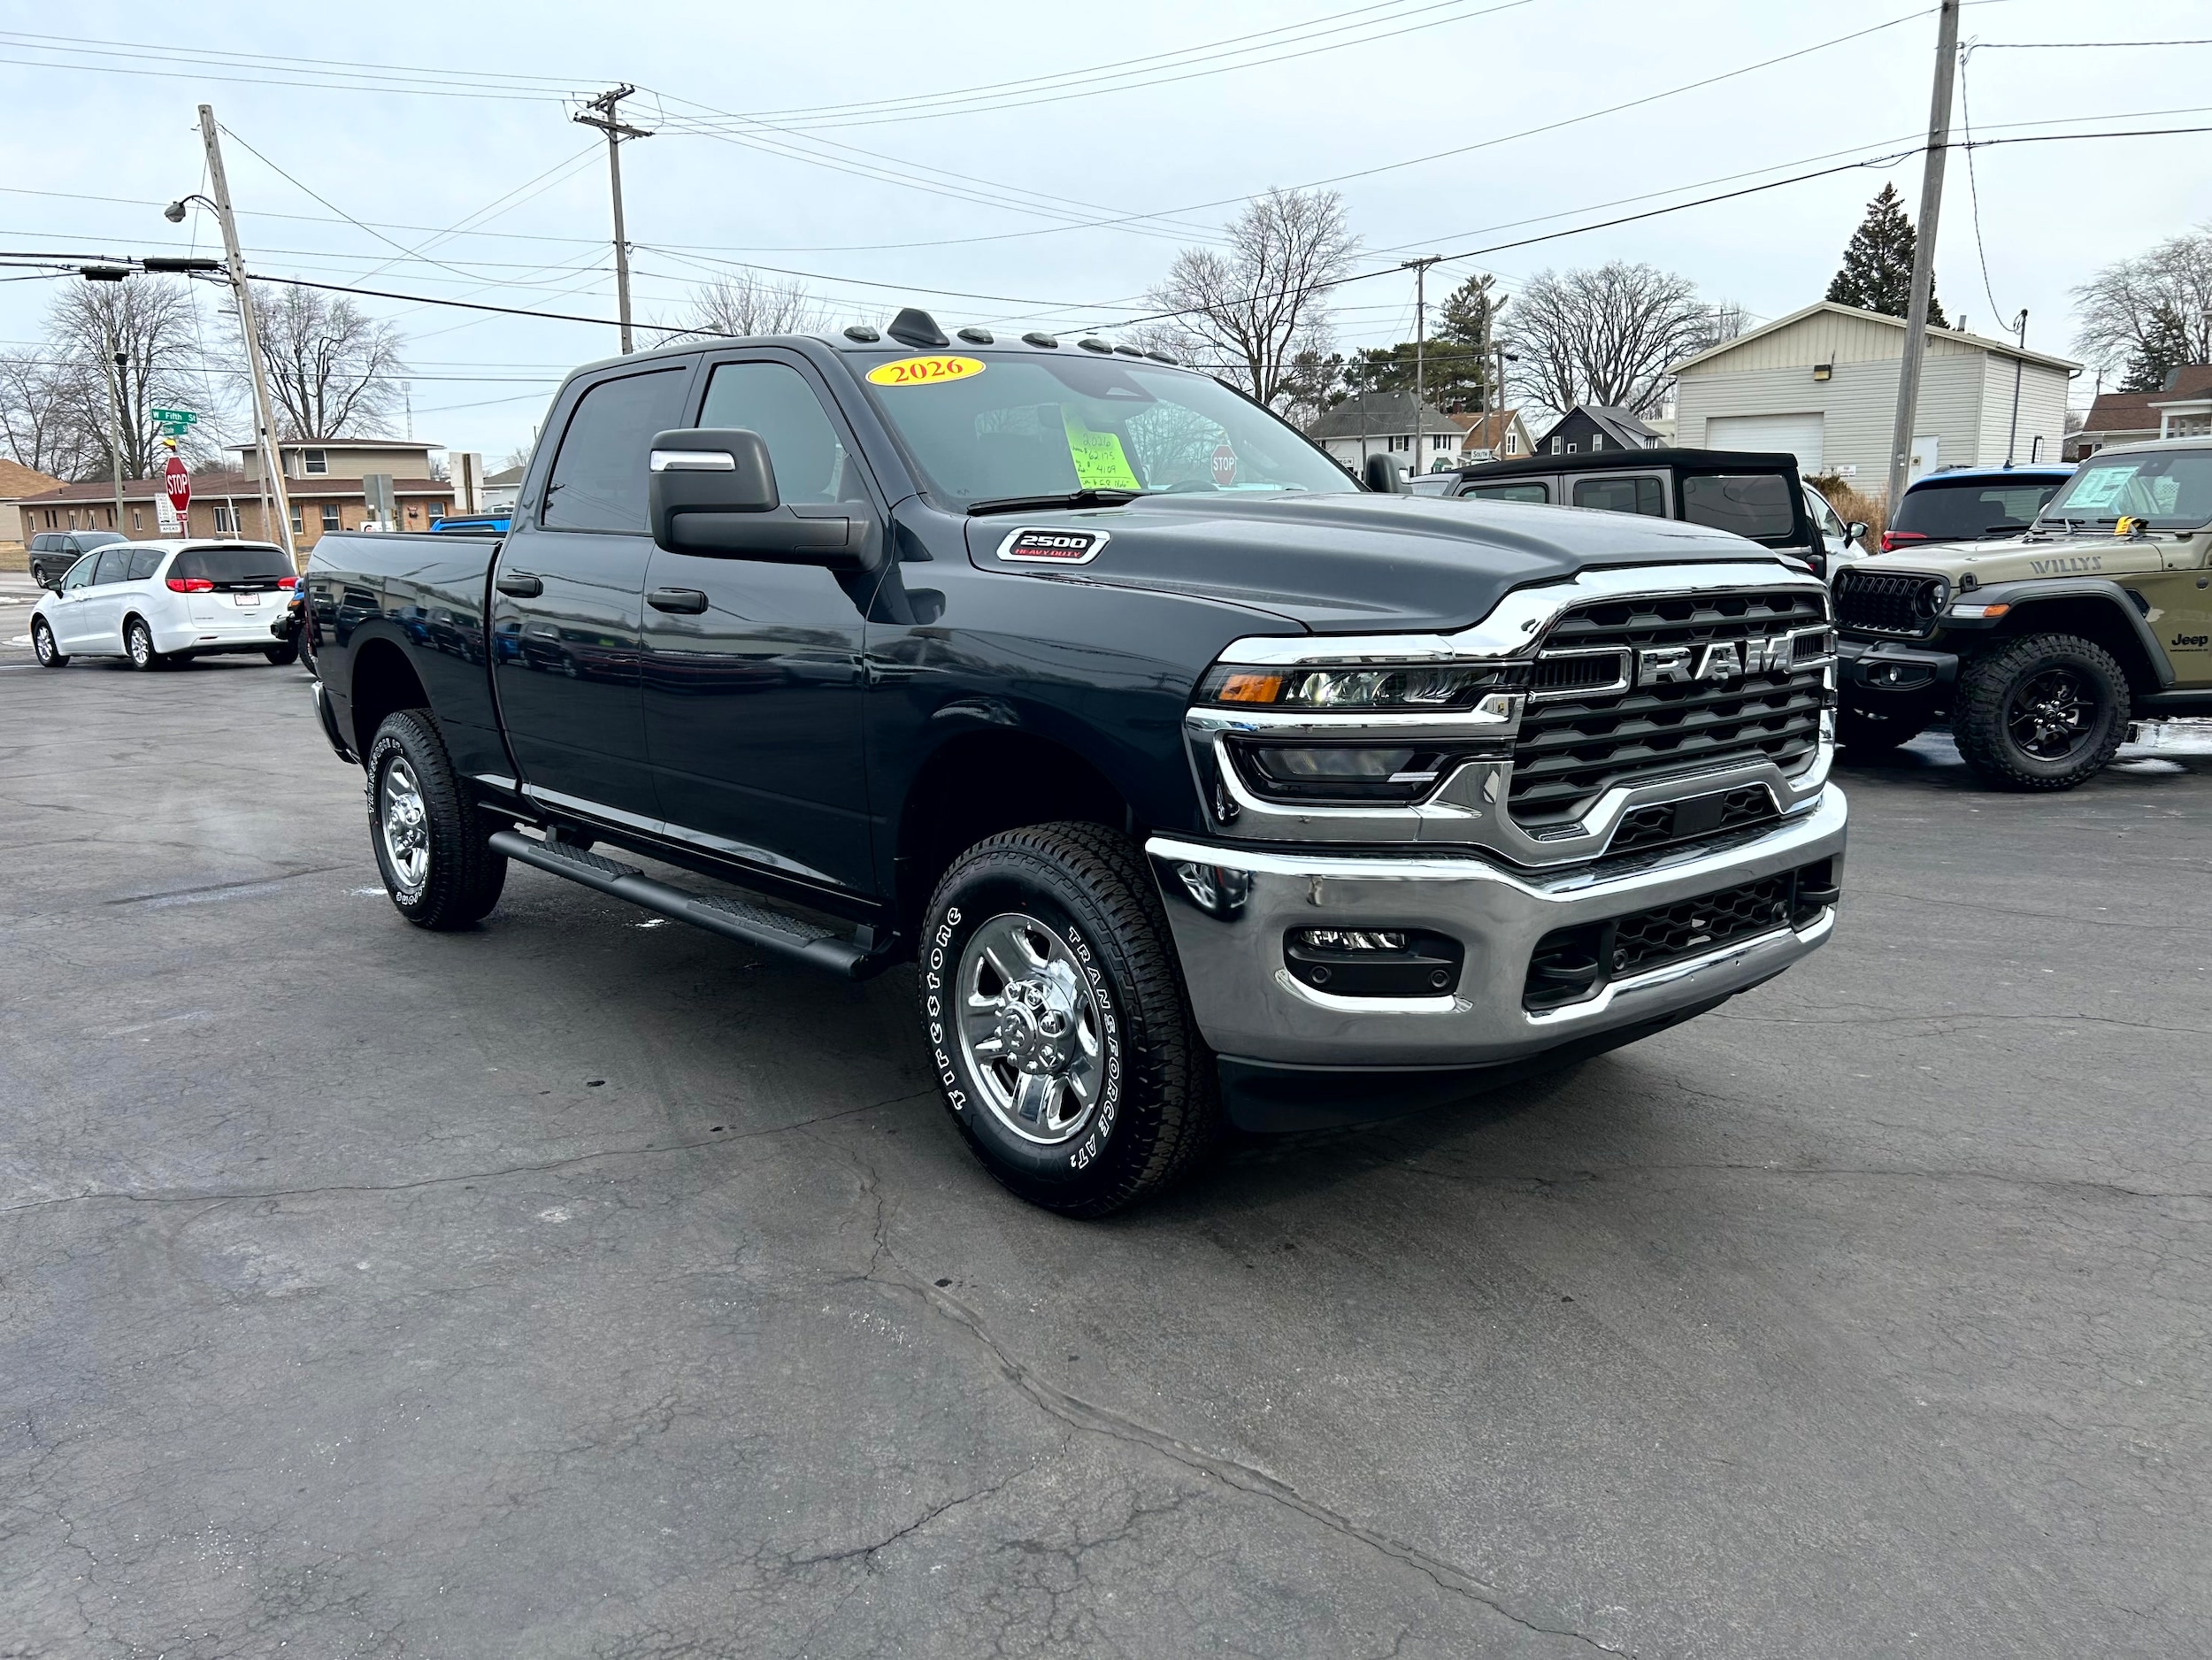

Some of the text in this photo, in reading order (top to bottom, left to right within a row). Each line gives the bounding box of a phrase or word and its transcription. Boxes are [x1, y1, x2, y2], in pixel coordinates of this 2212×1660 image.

[890, 358, 963, 383] 2026
[165, 411, 182, 421] Fifth
[188, 413, 196, 422] St
[1082, 433, 1111, 448] 2026
[1213, 457, 1235, 471] STOP
[166, 473, 188, 496] STOP
[1020, 534, 1087, 549] 2500
[2030, 556, 2101, 574] WILLYS
[2171, 633, 2208, 647] Jeep
[1637, 635, 1788, 687] RAM
[926, 907, 967, 1111] Firestone
[1069, 926, 1120, 1138] TRANSFORCE
